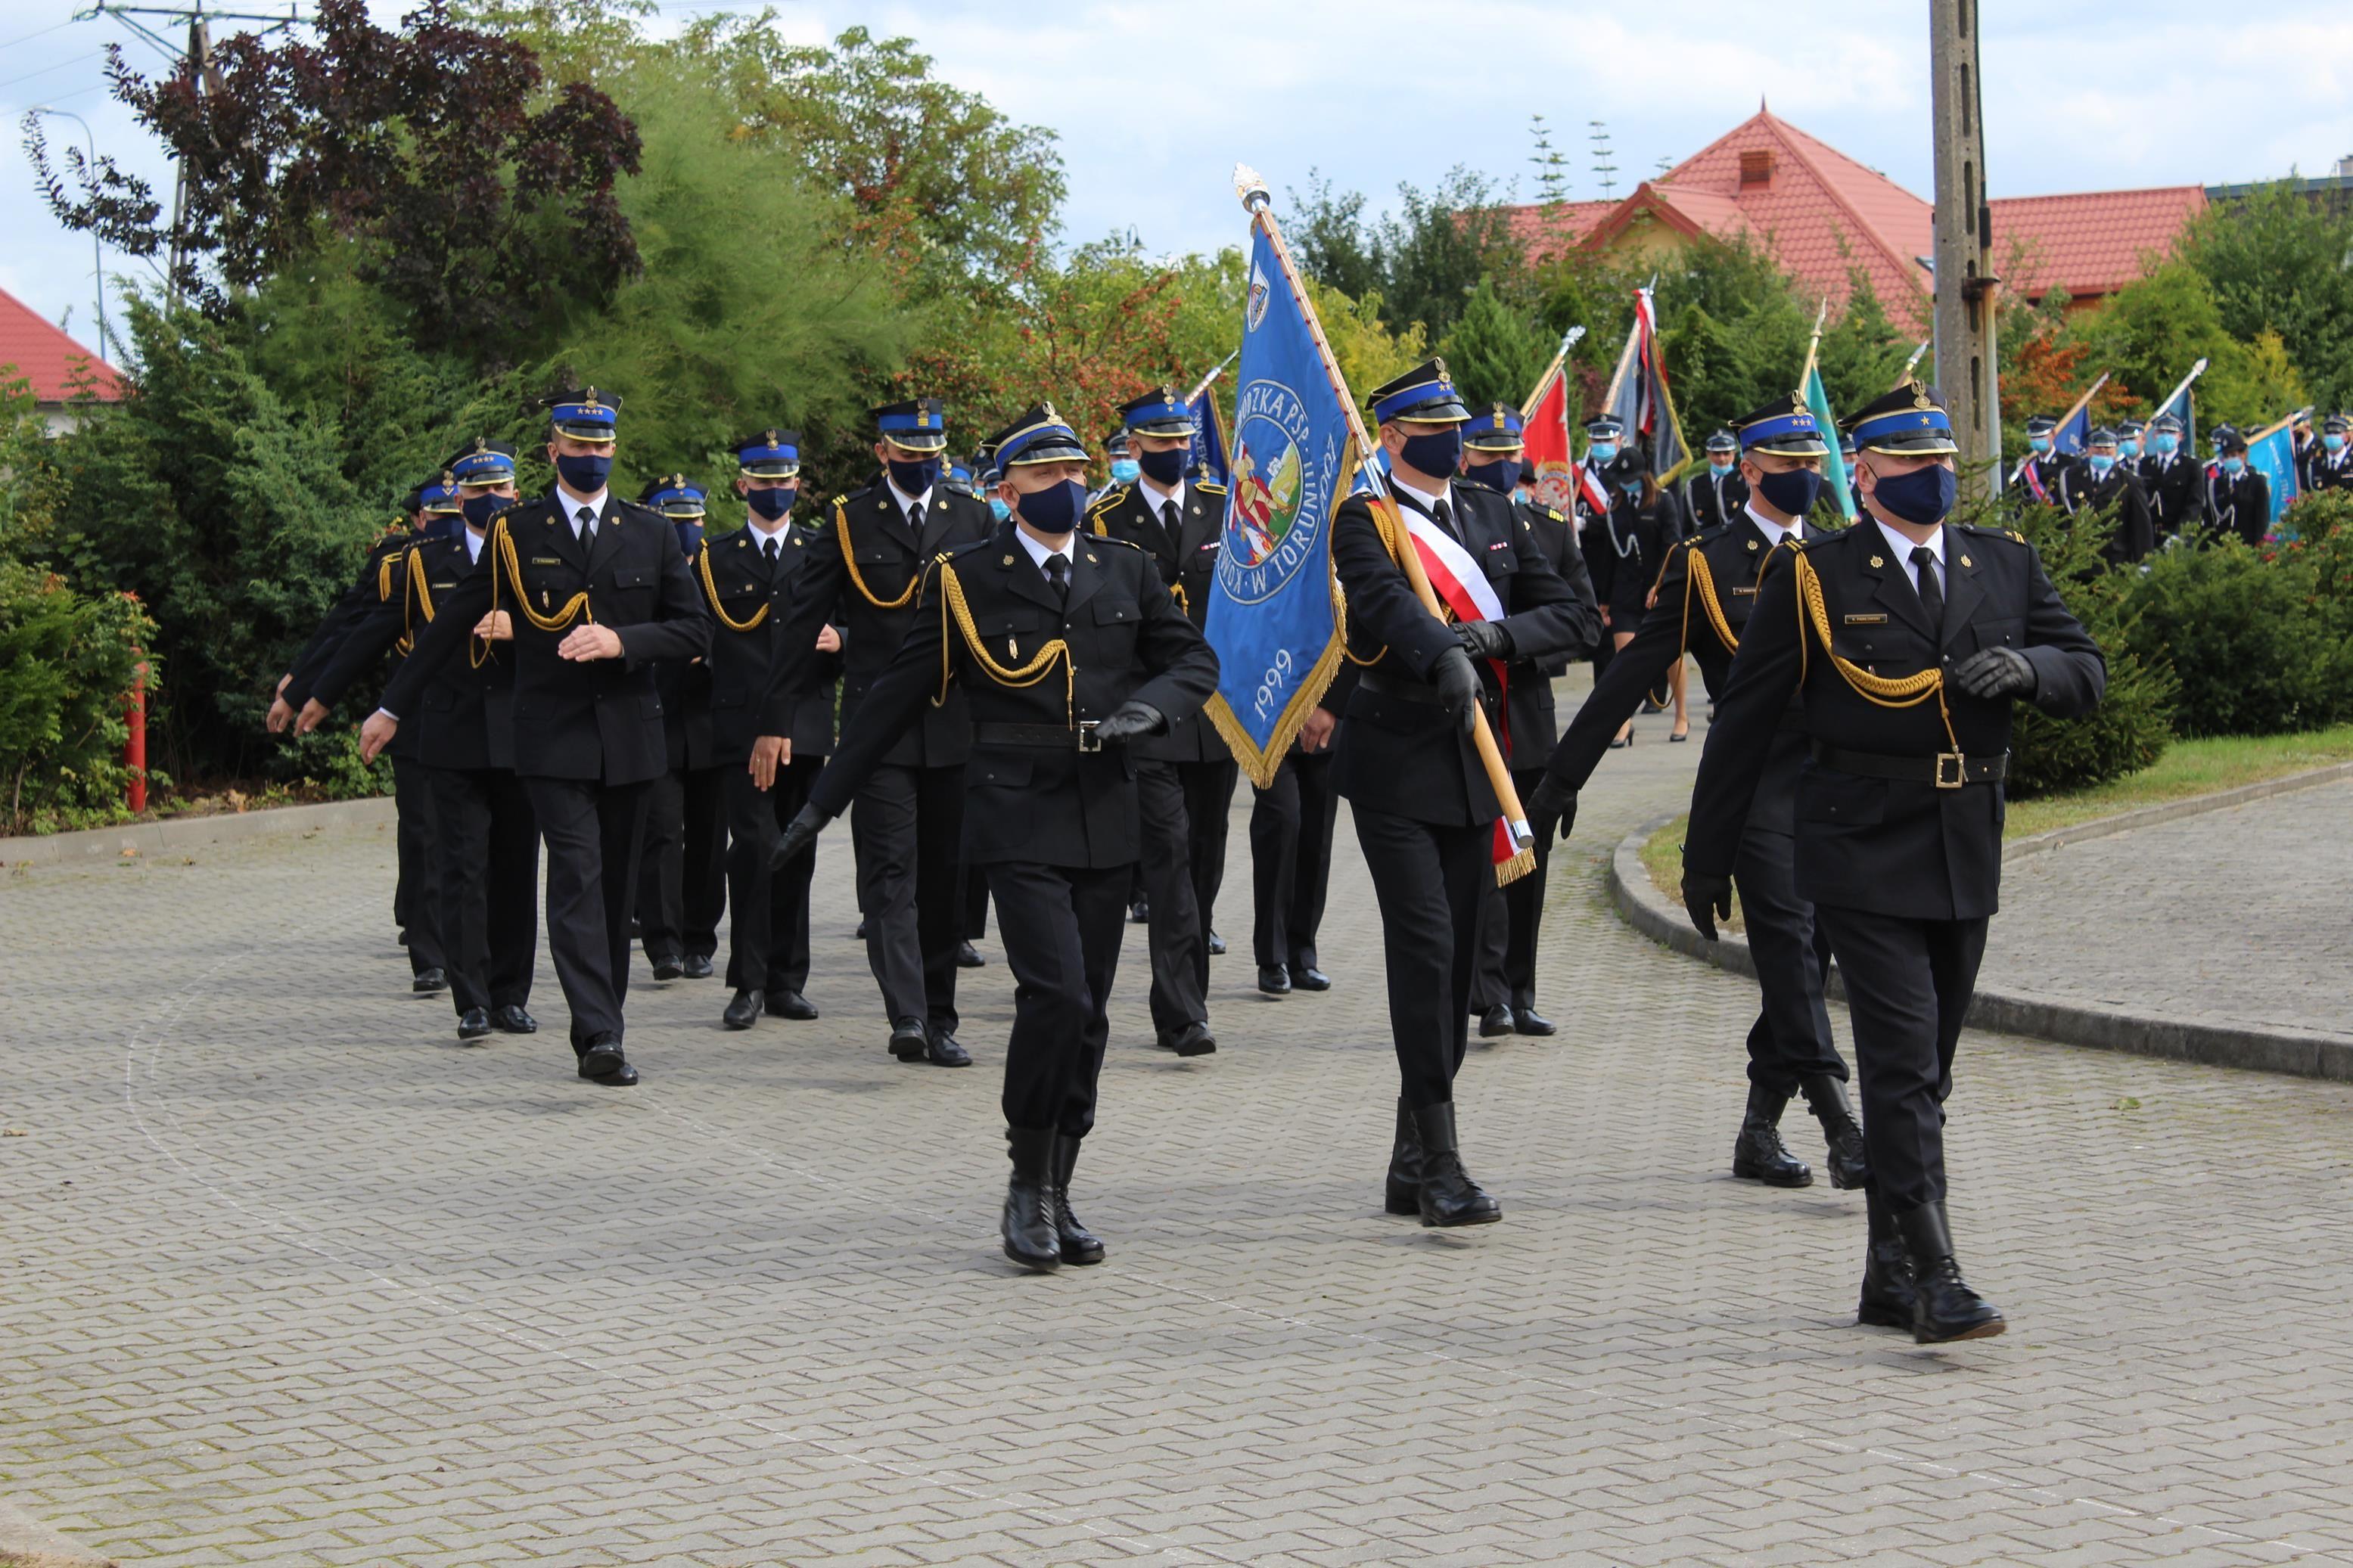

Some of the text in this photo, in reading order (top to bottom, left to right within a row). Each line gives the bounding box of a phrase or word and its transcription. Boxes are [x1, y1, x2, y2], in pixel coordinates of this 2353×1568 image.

[1284, 402, 1309, 443] PSP
[1251, 566, 1267, 595] W
[1254, 648, 1292, 722] 1999
